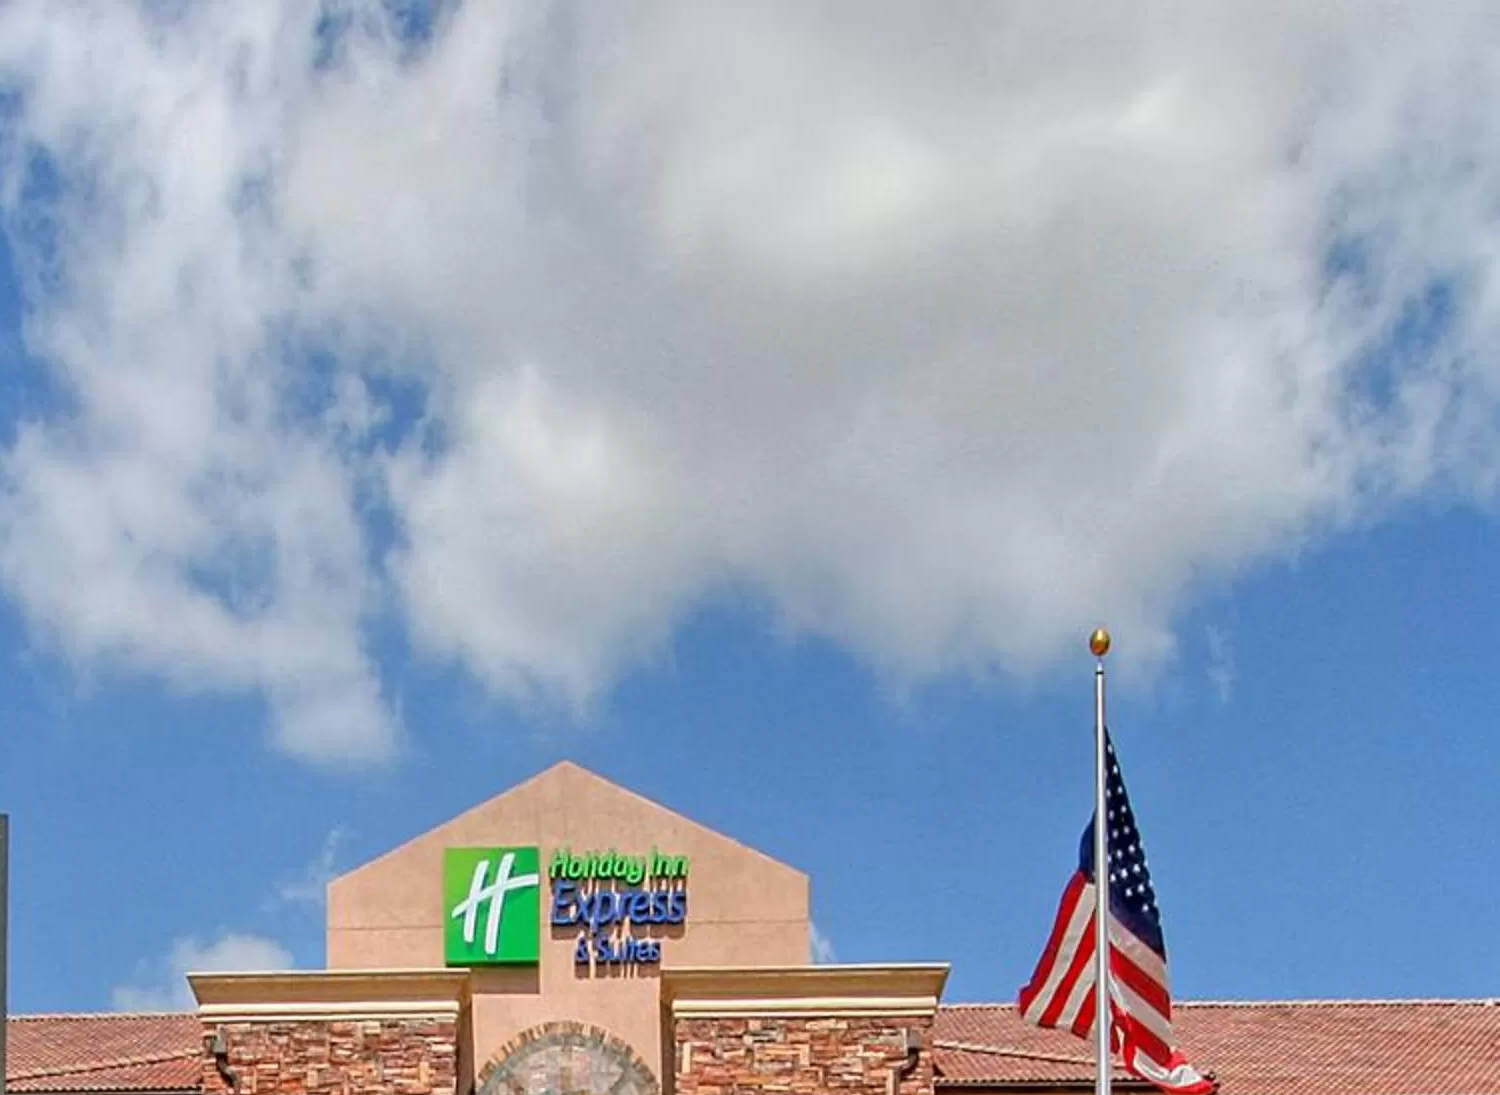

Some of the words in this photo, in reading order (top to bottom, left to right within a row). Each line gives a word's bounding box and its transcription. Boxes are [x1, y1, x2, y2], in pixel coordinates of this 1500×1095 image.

[550, 851, 645, 884] Holiday
[649, 850, 688, 877] Inn
[552, 880, 687, 934] Express
[575, 937, 589, 961] &
[594, 935, 661, 962] Suites
